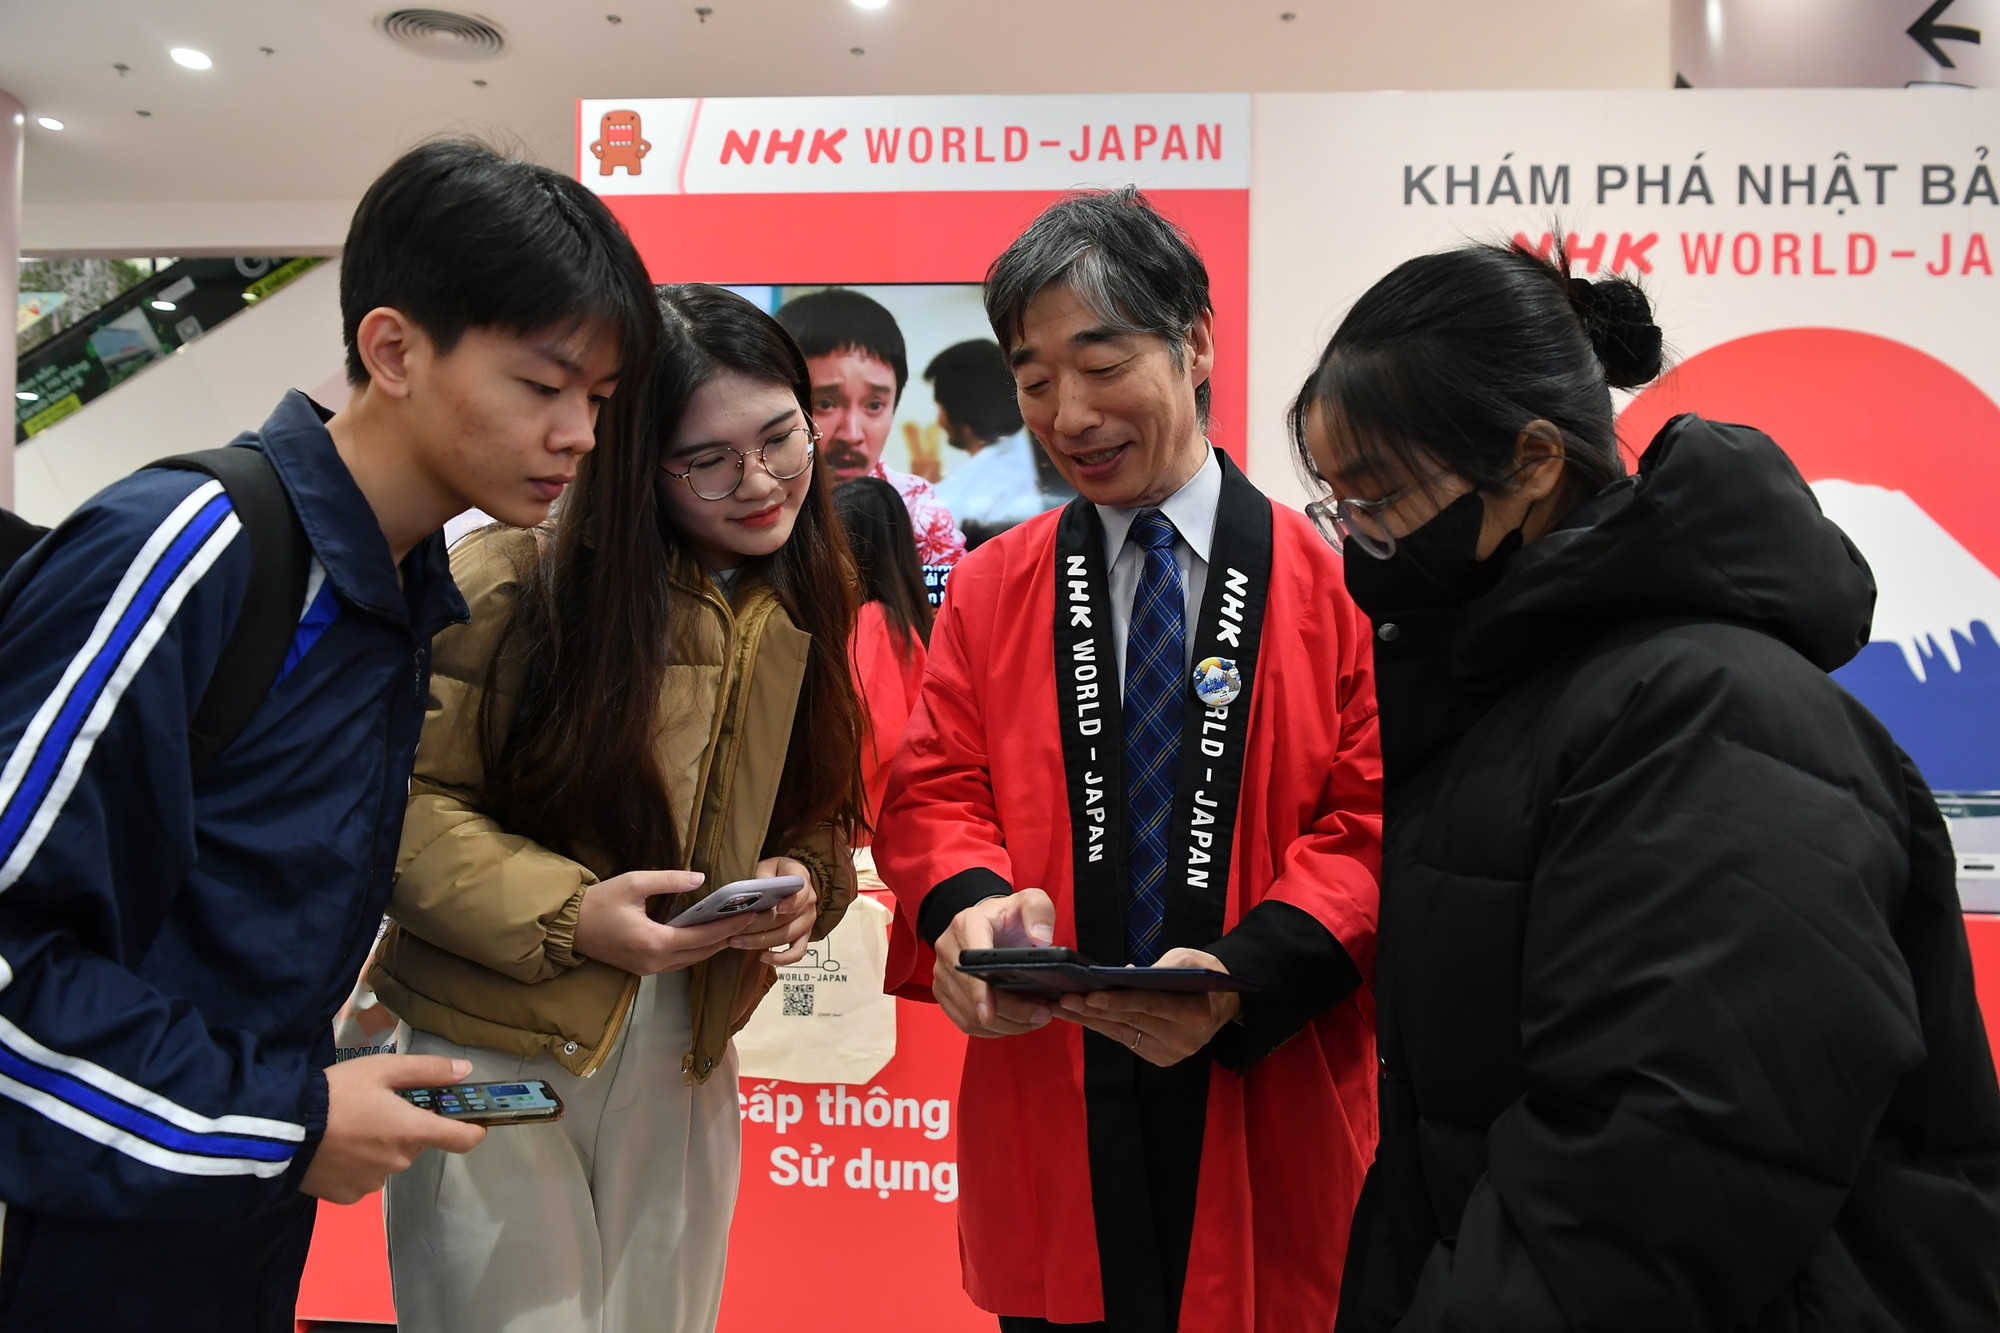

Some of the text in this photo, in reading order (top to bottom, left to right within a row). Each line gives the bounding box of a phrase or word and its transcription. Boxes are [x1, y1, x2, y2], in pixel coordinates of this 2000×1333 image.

[720, 128, 847, 165] NHK
[1403, 146, 2000, 215] KHÁM PHÁ NHẬT BẢ
[1066, 555, 1093, 629] NHK
[1216, 567, 1249, 648] NHK
[1072, 638, 1102, 736] WORLD
[1084, 771, 1106, 862] JAPAN
[1187, 790, 1218, 888] JAPAN
[816, 1084, 950, 1140] thông
[769, 1142, 959, 1203] Sử dụng
